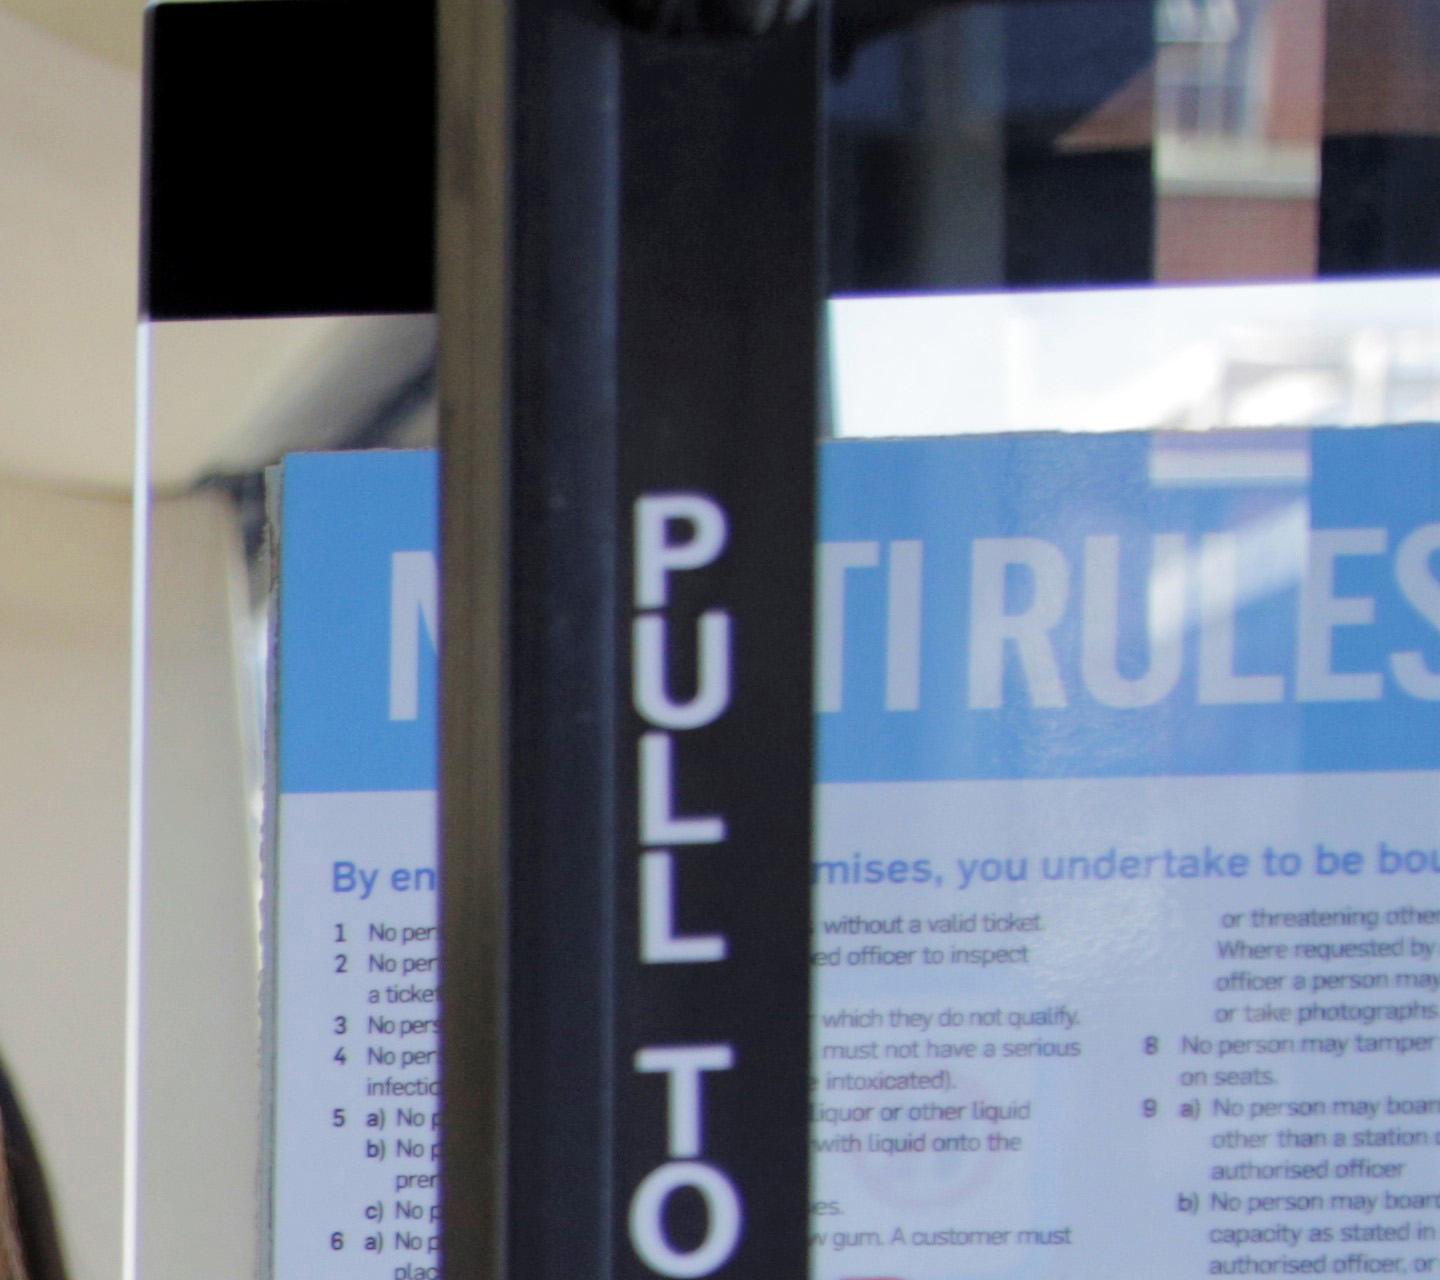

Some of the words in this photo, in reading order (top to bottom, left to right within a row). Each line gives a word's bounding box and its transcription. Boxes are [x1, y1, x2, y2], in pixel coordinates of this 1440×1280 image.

[632, 495, 731, 962] PULL
[333, 861, 378, 900] By
[811, 851, 943, 888] mises,
[957, 858, 1028, 890] you
[1043, 845, 1249, 882] undertake
[1262, 847, 1302, 877] to
[1316, 844, 1364, 876] be
[336, 923, 346, 942] 1
[369, 924, 397, 941] No
[824, 914, 903, 934] without
[908, 919, 922, 934] a
[927, 914, 977, 933] valid
[1221, 913, 1244, 928] or
[1251, 909, 1380, 931] threatening
[335, 954, 347, 973] 2
[369, 954, 397, 972] No
[846, 945, 916, 966] officer
[921, 947, 944, 965] to
[950, 946, 1029, 968] inspect
[1218, 940, 1289, 959] Where
[368, 989, 380, 1004] a
[335, 1016, 347, 1035] 3
[368, 1016, 395, 1034] No
[822, 1010, 882, 1028] which
[888, 1009, 933, 1032] they
[938, 1008, 964, 1027] do
[969, 1009, 1002, 1026] not
[1008, 1005, 1080, 1030] qualify.
[334, 1047, 346, 1064] 4
[368, 1047, 396, 1065] No
[823, 1042, 878, 1059] must
[885, 1041, 920, 1059] not
[926, 1040, 977, 1058] have
[982, 1043, 996, 1058] a
[1002, 1038, 1082, 1057] serious
[1144, 1036, 1158, 1055] 8
[1182, 1036, 1213, 1054] No
[1217, 1039, 1295, 1058] person
[1301, 1038, 1349, 1057] may
[1354, 1035, 1436, 1054] tamper
[826, 1069, 956, 1091] intoxicated).
[1180, 1071, 1207, 1086] on
[1214, 1068, 1276, 1086] seats.
[333, 1108, 345, 1127] 5
[366, 1109, 385, 1130] a)
[397, 1108, 425, 1127] No
[880, 1107, 902, 1121] or
[907, 1103, 966, 1121] other
[971, 1101, 1030, 1124] liquid
[366, 1140, 385, 1160] b)
[396, 1139, 424, 1158] No
[869, 1133, 926, 1155] liquid
[932, 1134, 980, 1152] onto
[986, 1132, 1021, 1152] the
[628, 1045, 742, 1277] TO
[365, 1201, 383, 1222] c)
[395, 1201, 423, 1219] No
[331, 1231, 343, 1250] 6
[364, 1232, 383, 1253] a)
[395, 1232, 422, 1250] No
[832, 1232, 884, 1251] gum.
[890, 1227, 906, 1244] A
[912, 1228, 1012, 1246] customer
[1018, 1227, 1072, 1245] must
